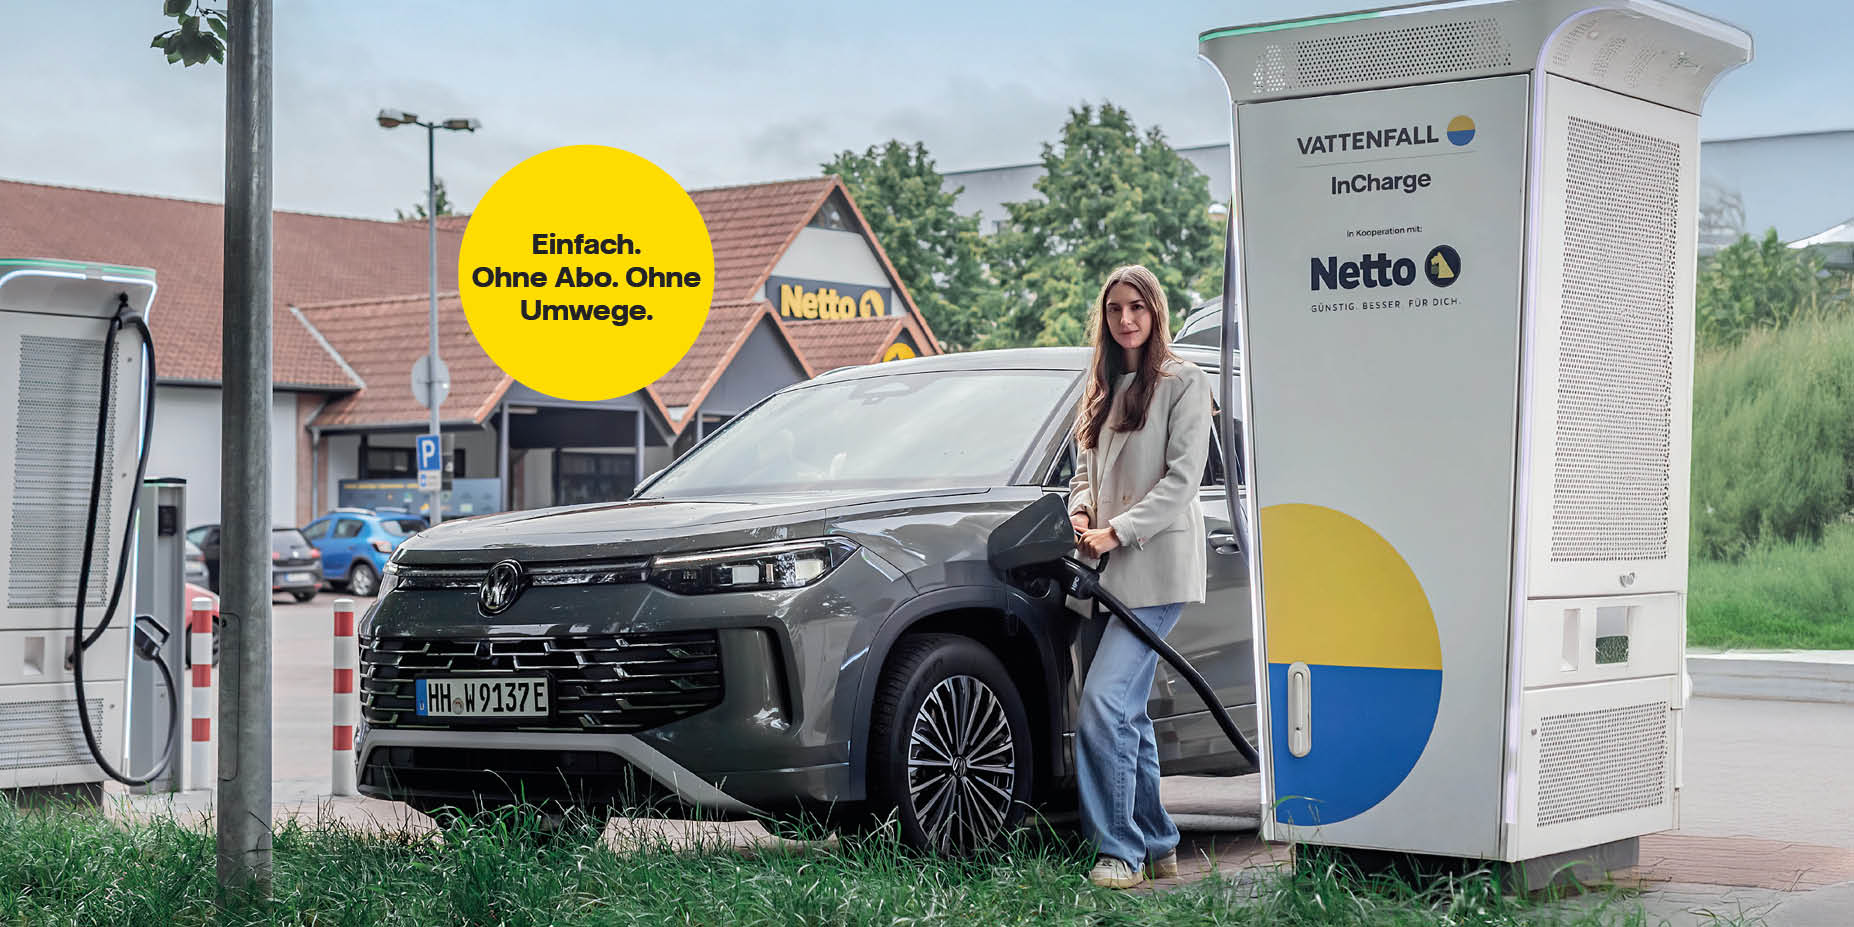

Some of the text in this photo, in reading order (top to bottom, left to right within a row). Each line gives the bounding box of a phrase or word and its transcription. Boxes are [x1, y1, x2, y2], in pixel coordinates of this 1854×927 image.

[1297, 125, 1439, 154] VATTENFALL
[1331, 173, 1431, 194] InCharge
[1355, 227, 1405, 238] Kooperation
[1406, 225, 1423, 233] mit:
[1310, 253, 1417, 291] Netto
[780, 283, 857, 320] Netto
[1408, 297, 1429, 307] FÜR
[422, 440, 436, 468] P
[428, 683, 452, 712] HH
